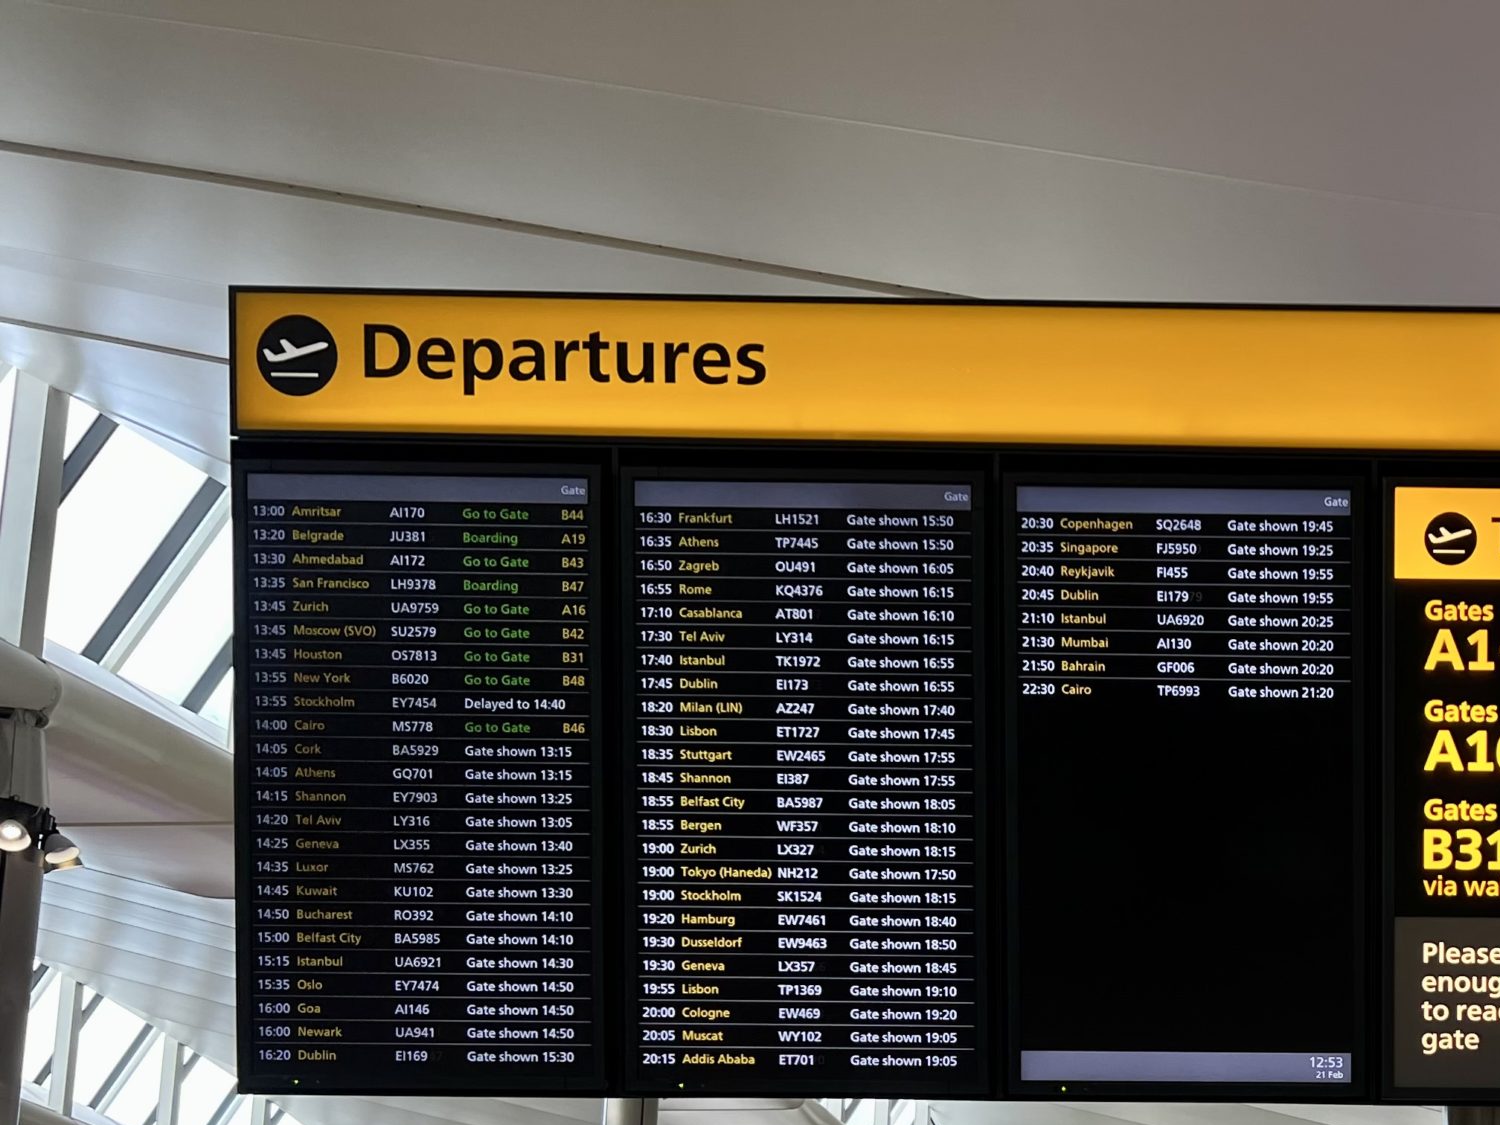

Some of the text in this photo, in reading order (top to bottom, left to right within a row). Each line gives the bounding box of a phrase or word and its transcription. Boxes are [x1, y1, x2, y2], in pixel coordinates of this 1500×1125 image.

[363, 323, 766, 396] Departures
[253, 505, 584, 520] 13:00 Amritsar AI170 Go to Gate B44
[1021, 518, 1333, 532] 20:30 Copenhagen SQ2648 Gate shown 19:45
[254, 529, 585, 546] 13:20 Belgrade JU381 Boarding A19
[1424, 599, 1494, 622] Gates
[1424, 699, 1498, 723] Gates
[1424, 798, 1498, 822] Gates
[642, 866, 956, 880] 19:00 Tokyo (Haneda) NH212 Gate shown 17:50
[1423, 875, 1457, 897] via
[1421, 1001, 1449, 1021] to
[1421, 1030, 1480, 1055] gate
[1310, 1056, 1343, 1068] 12:53
